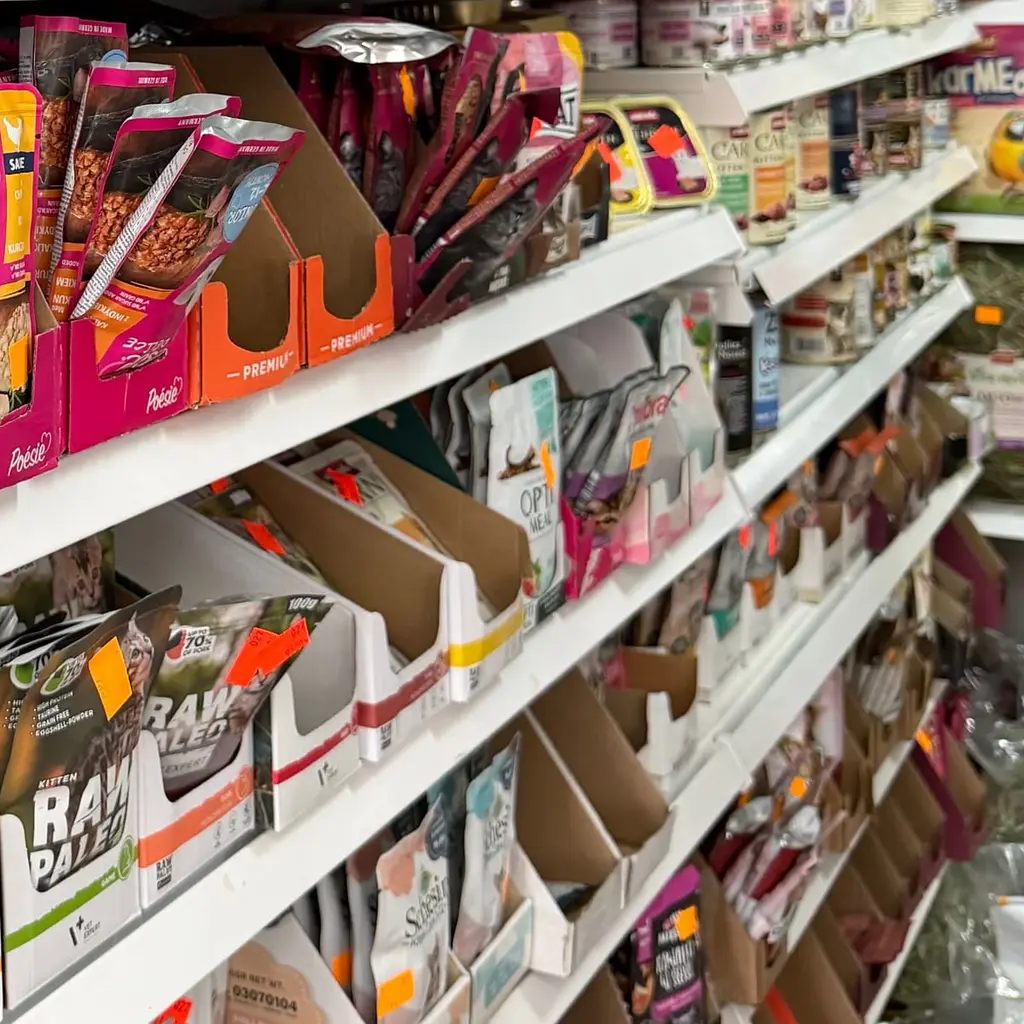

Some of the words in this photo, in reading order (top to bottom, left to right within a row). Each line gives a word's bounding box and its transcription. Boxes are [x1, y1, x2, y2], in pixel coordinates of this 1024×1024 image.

[331, 324, 374, 353] PREMIUM
[8, 444, 46, 476] Poésie
[288, 597, 318, 611] 100g
[186, 635, 212, 649] 70%
[36, 714, 55, 728] GRAIN
[56, 710, 70, 722] FREE
[143, 686, 237, 730] RAW
[35, 709, 94, 737] EGGSHELL-POWDER
[38, 772, 78, 789] KITTEN
[33, 756, 132, 847] RAW
[30, 809, 127, 891] PALEO
[232, 982, 298, 1013] 03070104
